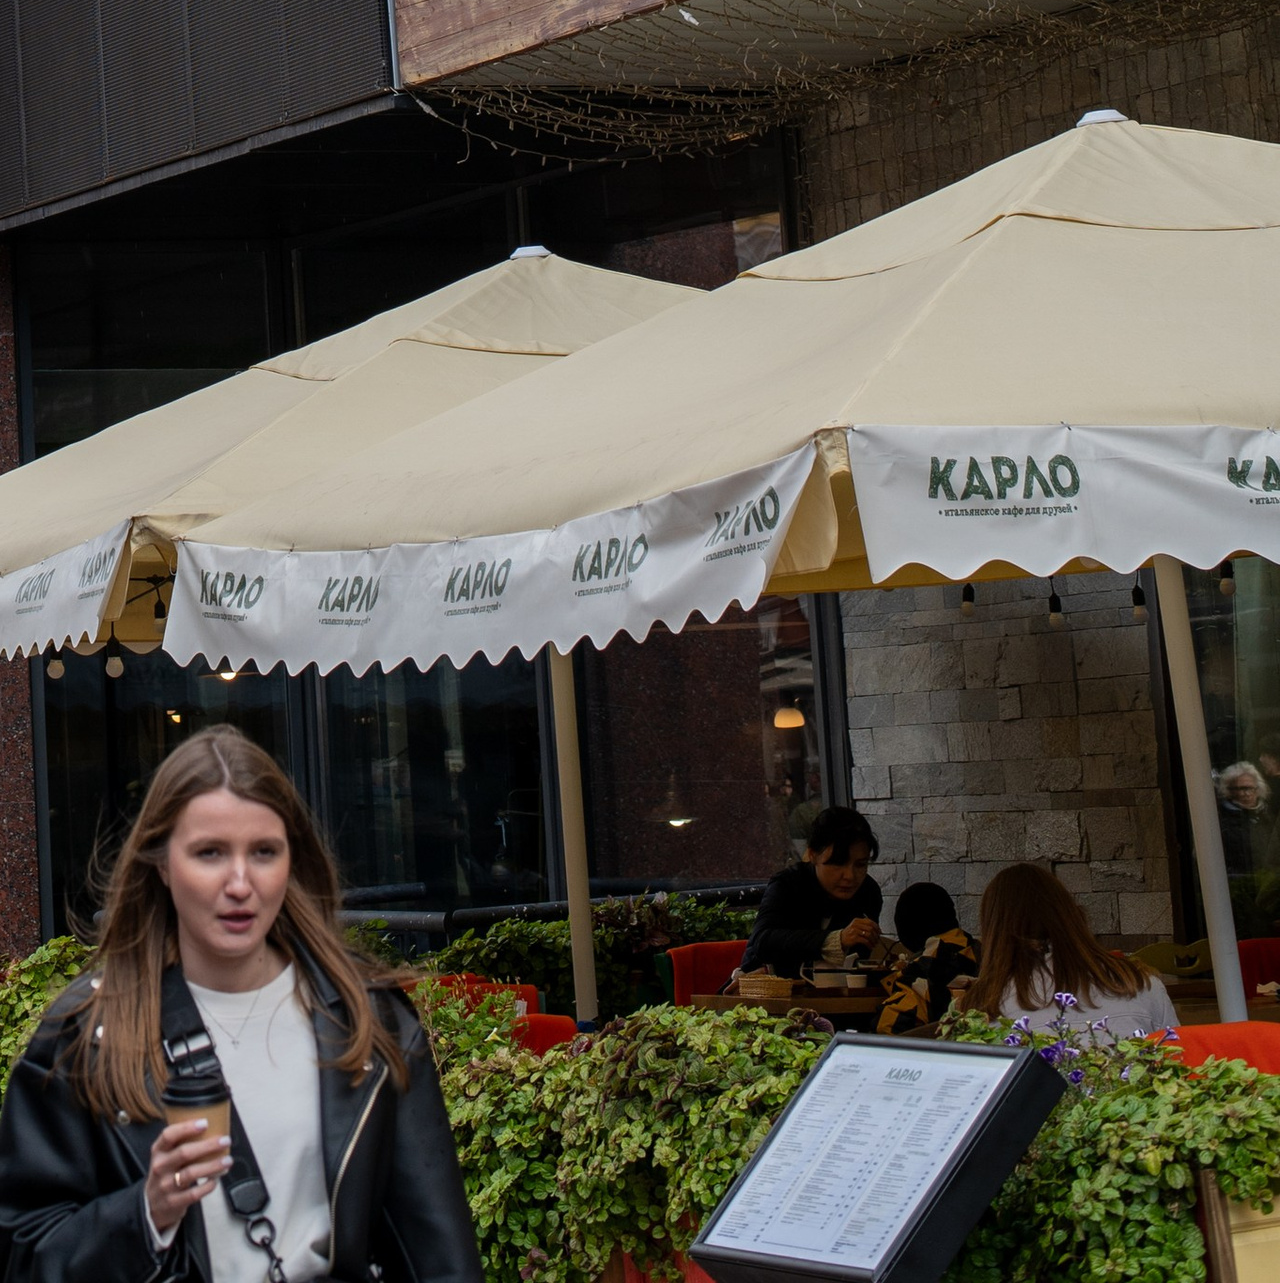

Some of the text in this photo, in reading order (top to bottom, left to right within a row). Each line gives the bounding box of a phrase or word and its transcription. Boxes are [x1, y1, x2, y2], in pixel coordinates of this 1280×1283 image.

[928, 454, 1081, 501] КАРЛО
[943, 502, 1073, 518] итальянское кафе для друзей
[572, 532, 649, 583] КАРЛО
[200, 569, 265, 610] КАРЛО
[443, 557, 512, 603] КАРЛО
[884, 1066, 923, 1082] КАРЛО
